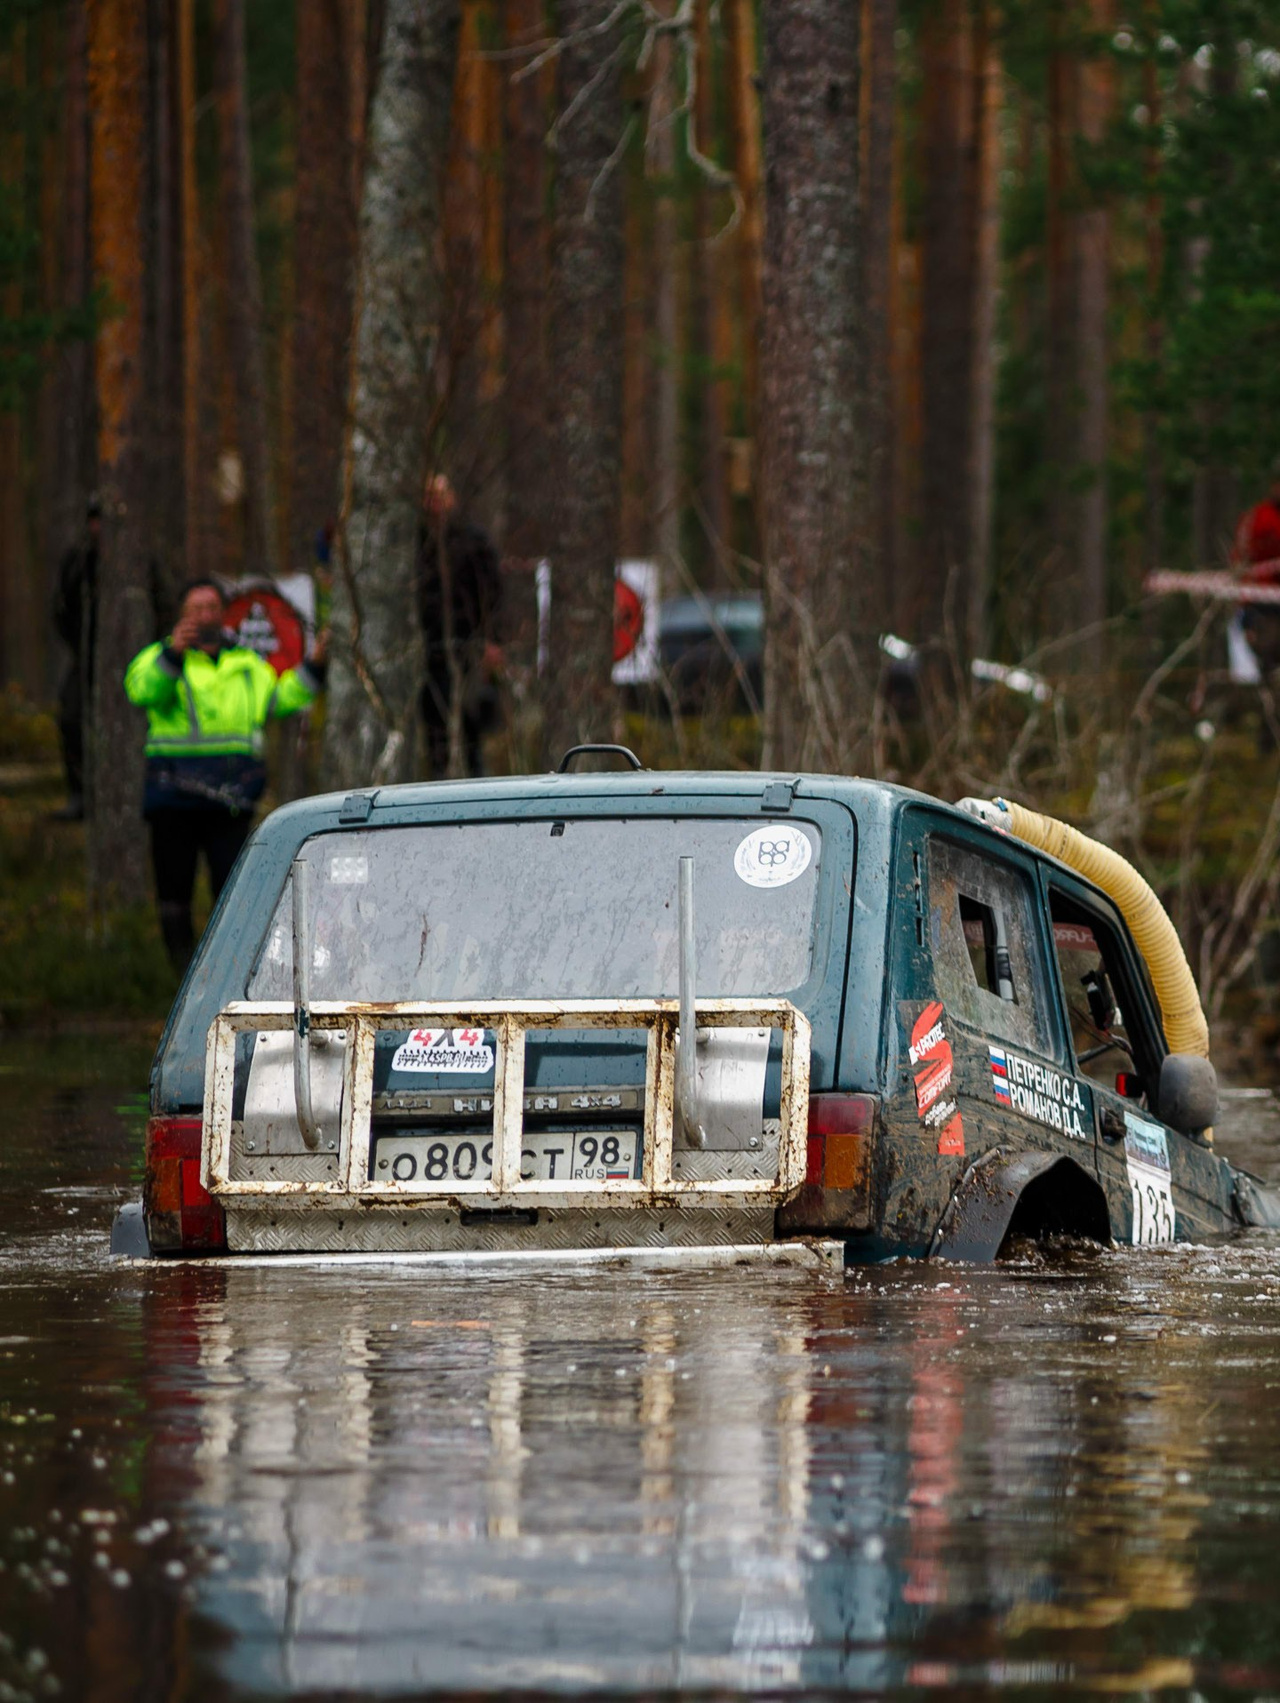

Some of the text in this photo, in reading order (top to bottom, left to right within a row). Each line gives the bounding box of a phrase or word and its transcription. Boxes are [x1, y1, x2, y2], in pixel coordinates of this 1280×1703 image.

[1006, 1053, 1061, 1101] ПЕТРЕНКО
[1009, 1081, 1062, 1129] РОМАНОВ
[579, 1136, 620, 1168] 98
[574, 1167, 605, 1180] RUS
